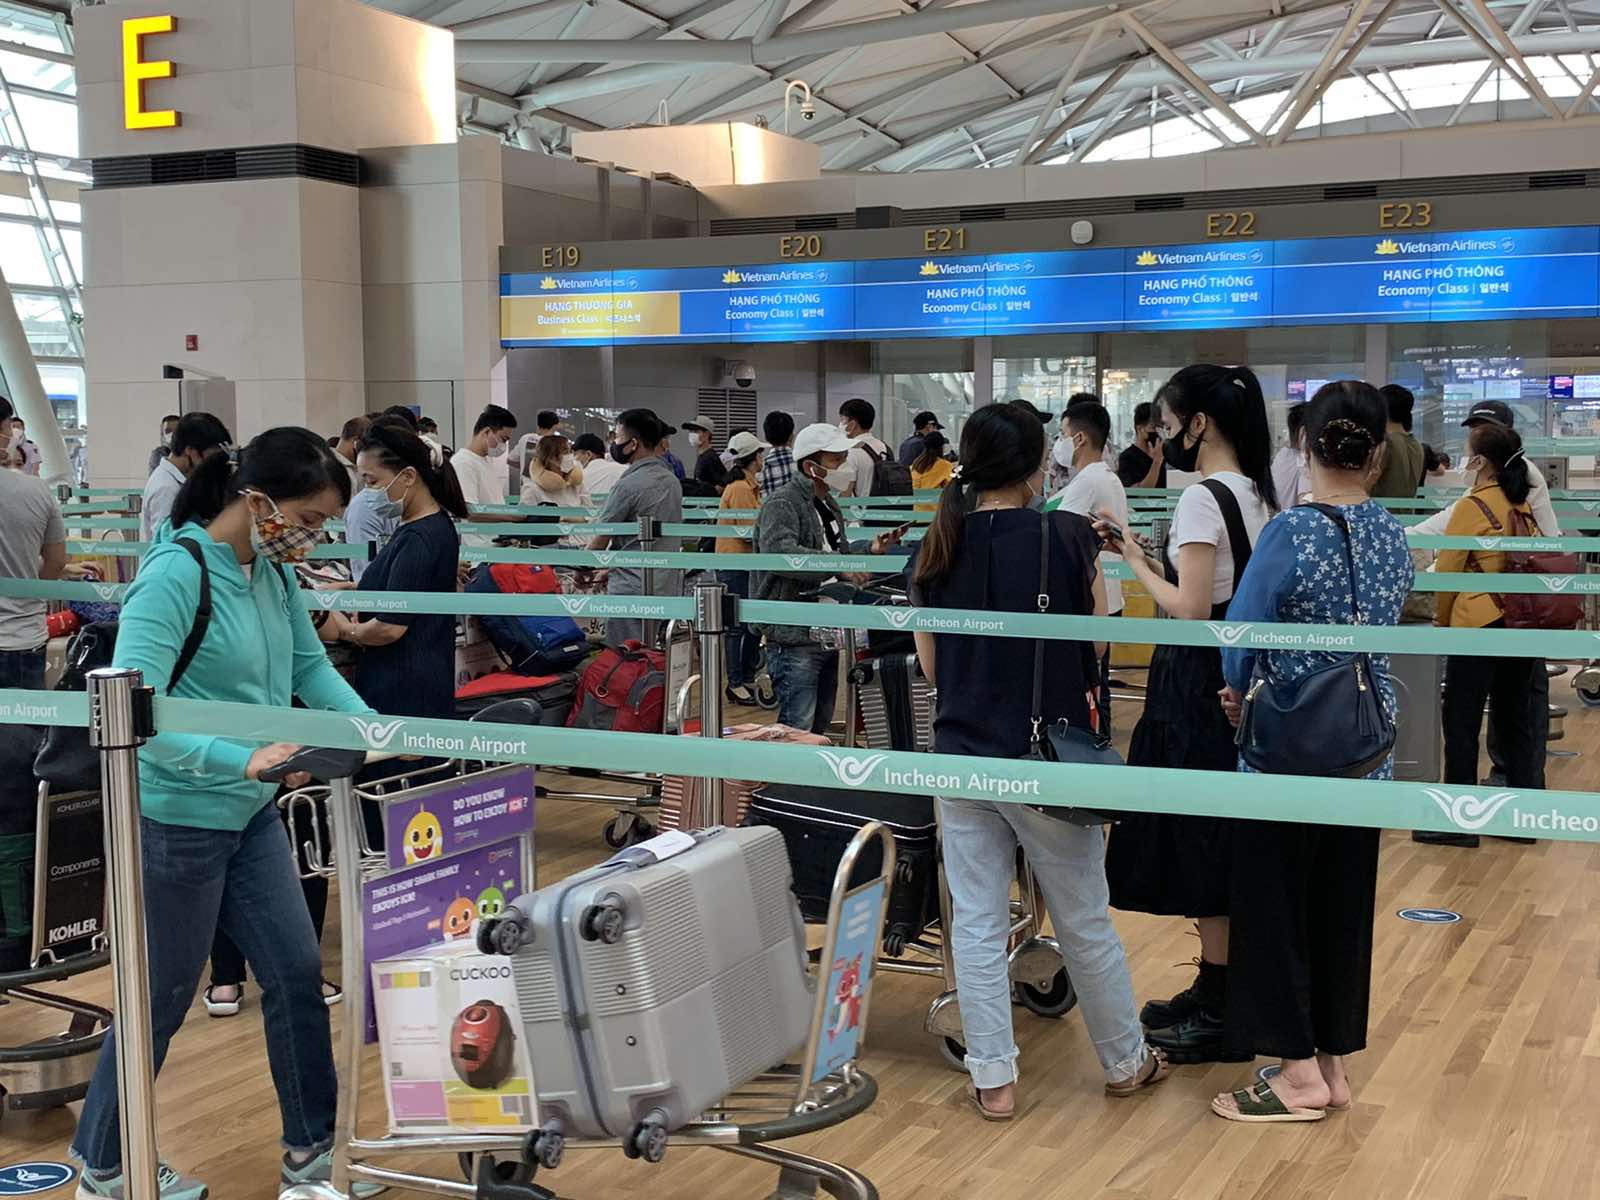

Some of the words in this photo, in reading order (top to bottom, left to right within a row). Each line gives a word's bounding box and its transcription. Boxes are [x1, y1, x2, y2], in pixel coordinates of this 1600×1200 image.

[122, 15, 181, 129] E
[1379, 202, 1432, 229] E23
[1206, 211, 1256, 238] E22
[779, 235, 821, 258] E20
[924, 228, 967, 250] E21
[541, 246, 580, 268] E19
[1383, 269, 1422, 283] HẠNG
[1143, 279, 1179, 293] HẠNG
[1377, 285, 1435, 297] Economy
[1437, 283, 1469, 295] Class
[922, 304, 970, 314] Economy
[970, 301, 998, 312] Class
[1138, 294, 1190, 306] Economy
[1192, 292, 1222, 304] Class
[725, 310, 768, 320] Economy
[770, 308, 795, 319] Class
[339, 597, 375, 609] Incheon
[376, 598, 408, 611] Airport
[589, 602, 628, 614] Incheon
[628, 603, 665, 617] Airport
[916, 615, 961, 629] Incheon
[963, 618, 1004, 632] Airport
[1250, 631, 1302, 645] Incheon
[1306, 633, 1354, 648] Airport
[14, 703, 58, 719] Airport
[403, 731, 464, 751] Incheon
[469, 734, 527, 757] Airport
[884, 767, 960, 790] Incheon
[968, 772, 1040, 797] Airport
[1513, 808, 1600, 832] Incheo
[49, 918, 98, 944] KOHLER
[450, 966, 511, 981] CUCKOO
